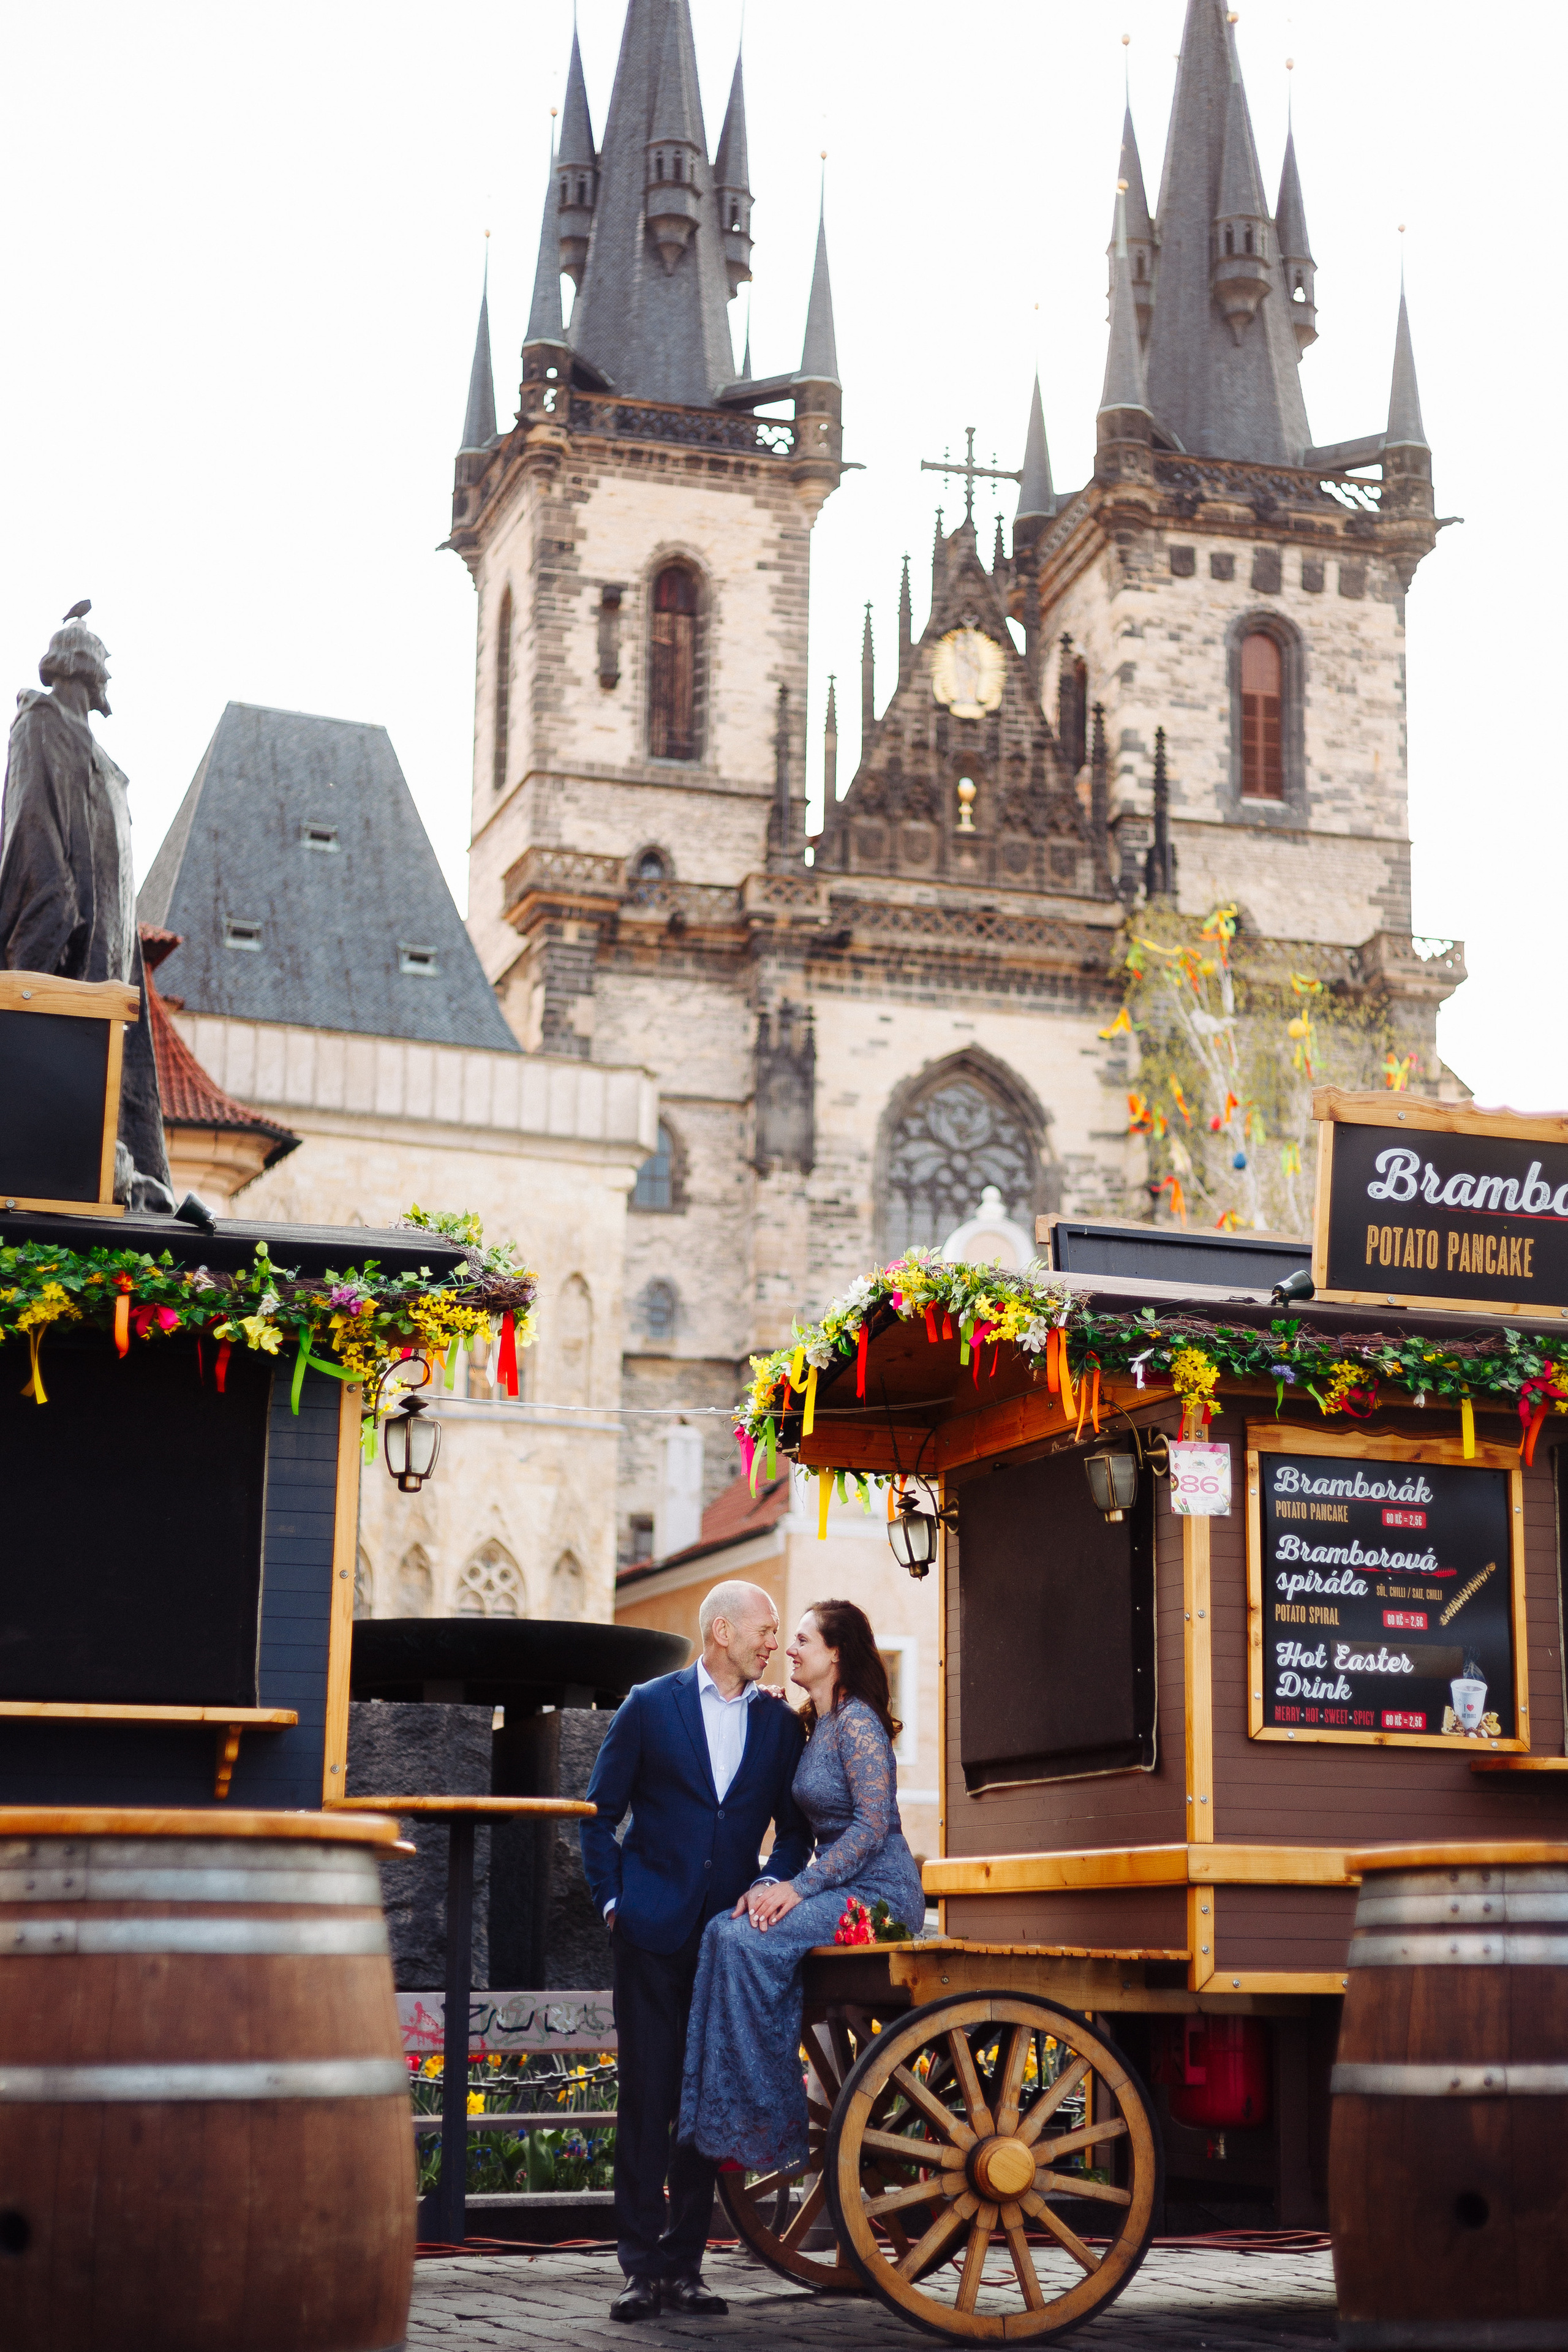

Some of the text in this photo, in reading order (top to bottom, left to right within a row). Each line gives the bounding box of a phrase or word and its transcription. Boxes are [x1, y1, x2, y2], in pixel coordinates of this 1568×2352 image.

[1366, 1224, 1534, 1278] POTATO PANCAKE
[1180, 1474, 1219, 1494] 86
[1273, 1466, 1434, 1503] Bramborák
[1275, 1500, 1349, 1523] POTATO PANCAKE
[1386, 1513, 1393, 1524] 60
[1395, 1512, 1402, 1525] KČ
[1409, 1515, 1422, 1526] 2,5€
[1275, 1534, 1438, 1570] Bramborová
[1276, 1569, 1368, 1601] spirála
[1389, 1586, 1406, 1598] CHILLI
[1412, 1588, 1425, 1600] SALT,
[1426, 1589, 1442, 1600] CHILLI
[1275, 1604, 1340, 1626] POTATO SPIRAL
[1387, 1614, 1395, 1625] 60
[1396, 1613, 1403, 1626] KČ
[1411, 1616, 1423, 1627] 2,5€
[1276, 1641, 1414, 1673] Hot Easter
[1276, 1671, 1352, 1700] Drink
[1275, 1705, 1374, 1726] MERRY HOT SWEET SPICY
[1385, 1714, 1393, 1725] 60
[1395, 1714, 1402, 1726] KČ
[1409, 1716, 1422, 1728] 2,5€
